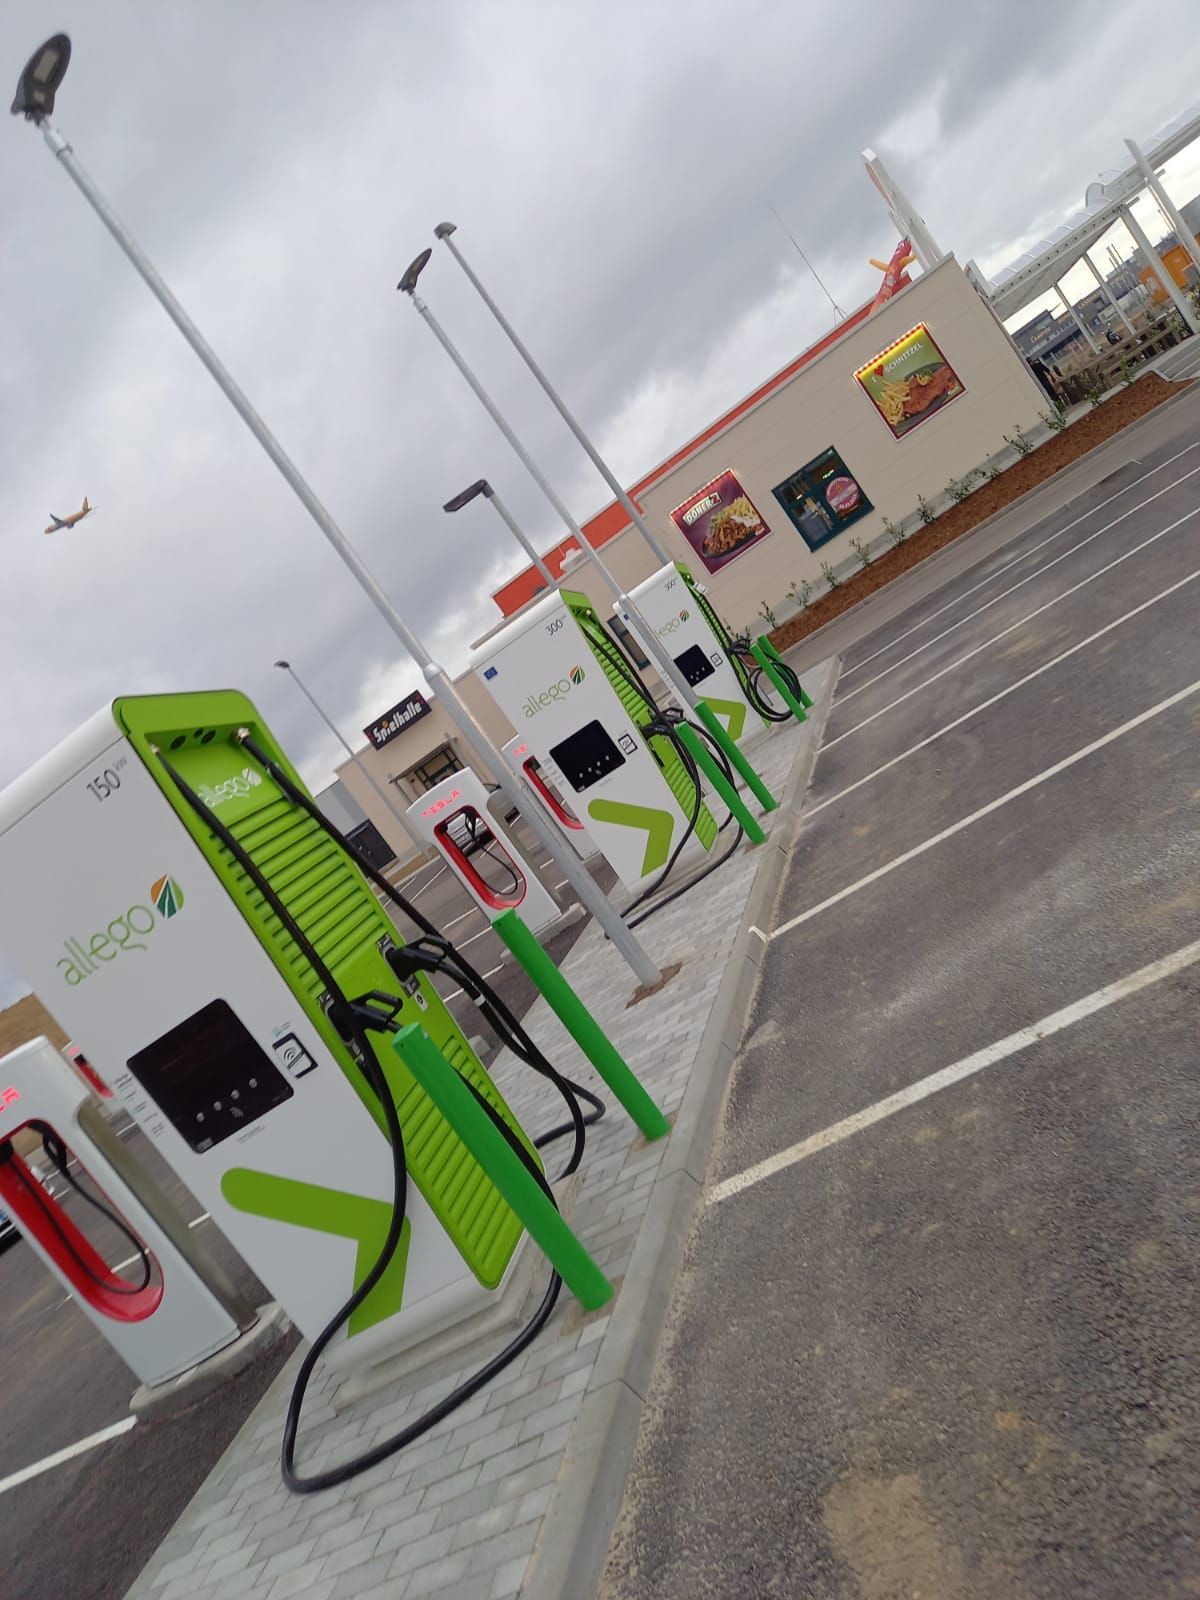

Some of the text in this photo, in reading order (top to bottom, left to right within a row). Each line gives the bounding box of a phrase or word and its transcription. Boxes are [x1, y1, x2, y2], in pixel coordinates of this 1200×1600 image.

[885, 342, 924, 372] SCHNITZEL
[545, 619, 564, 636] 300
[522, 679, 571, 718] allego
[372, 701, 423, 743] Spielhalle
[86, 769, 121, 802] 150
[422, 789, 461, 818] TESLA
[56, 905, 156, 986] allego
